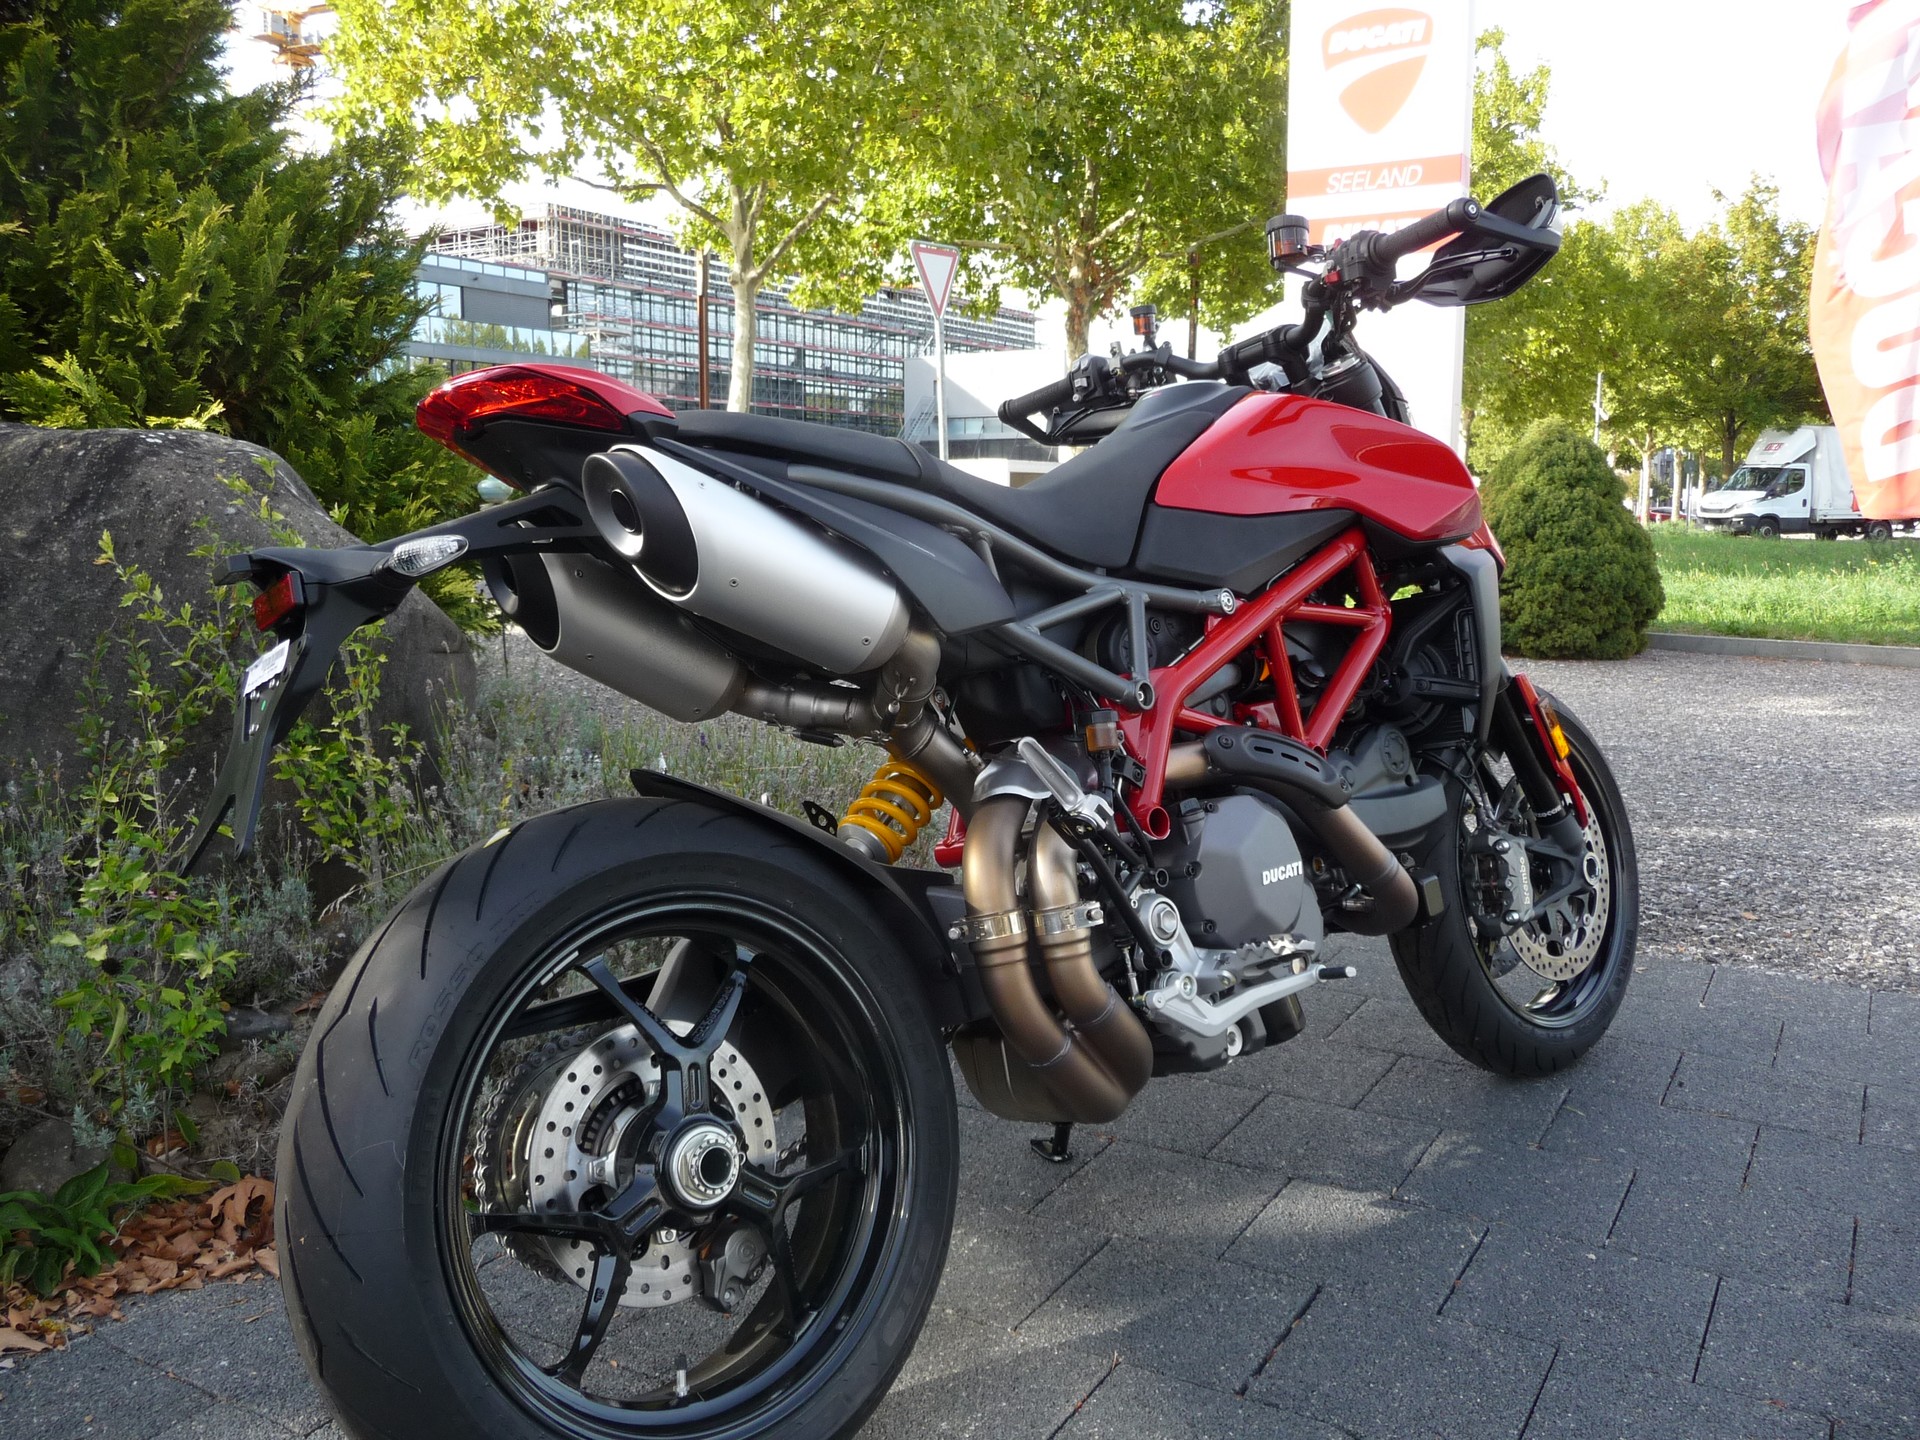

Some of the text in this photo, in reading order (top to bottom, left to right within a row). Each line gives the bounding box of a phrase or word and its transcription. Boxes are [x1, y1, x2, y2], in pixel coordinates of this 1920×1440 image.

[1328, 18, 1427, 55] DUCATI
[1326, 165, 1423, 194] SEELAND
[1262, 861, 1303, 885] DUCATI
[1519, 856, 1531, 905] brembo
